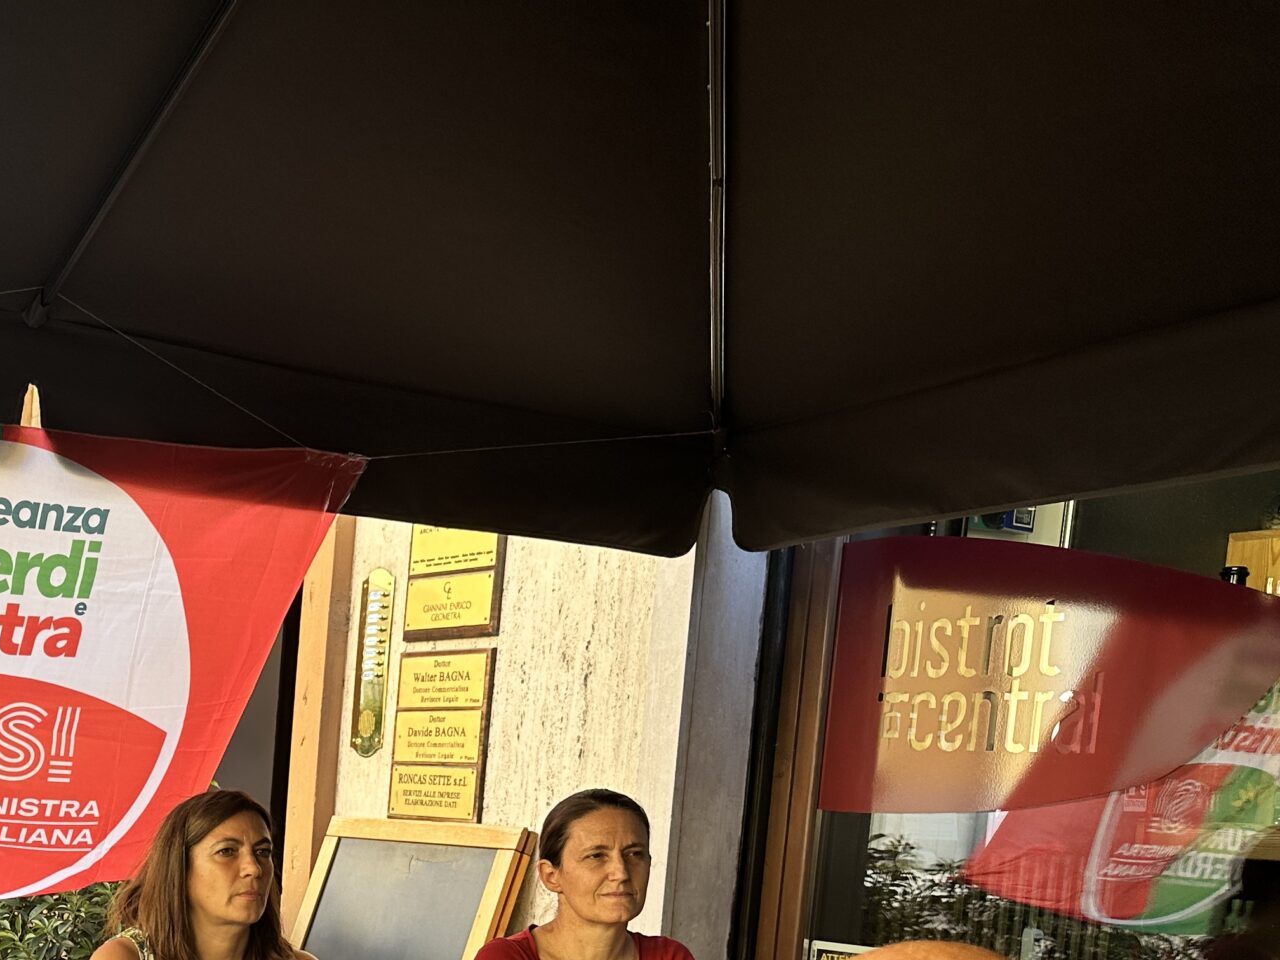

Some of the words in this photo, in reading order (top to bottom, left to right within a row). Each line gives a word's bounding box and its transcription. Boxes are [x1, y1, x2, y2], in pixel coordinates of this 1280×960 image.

[74, 601, 87, 616] e
[413, 672, 437, 682] Walter
[439, 671, 471, 681] BAGNA
[407, 727, 433, 737] Davide
[434, 726, 466, 737] BAGNA
[428, 774, 453, 786] SETTE
